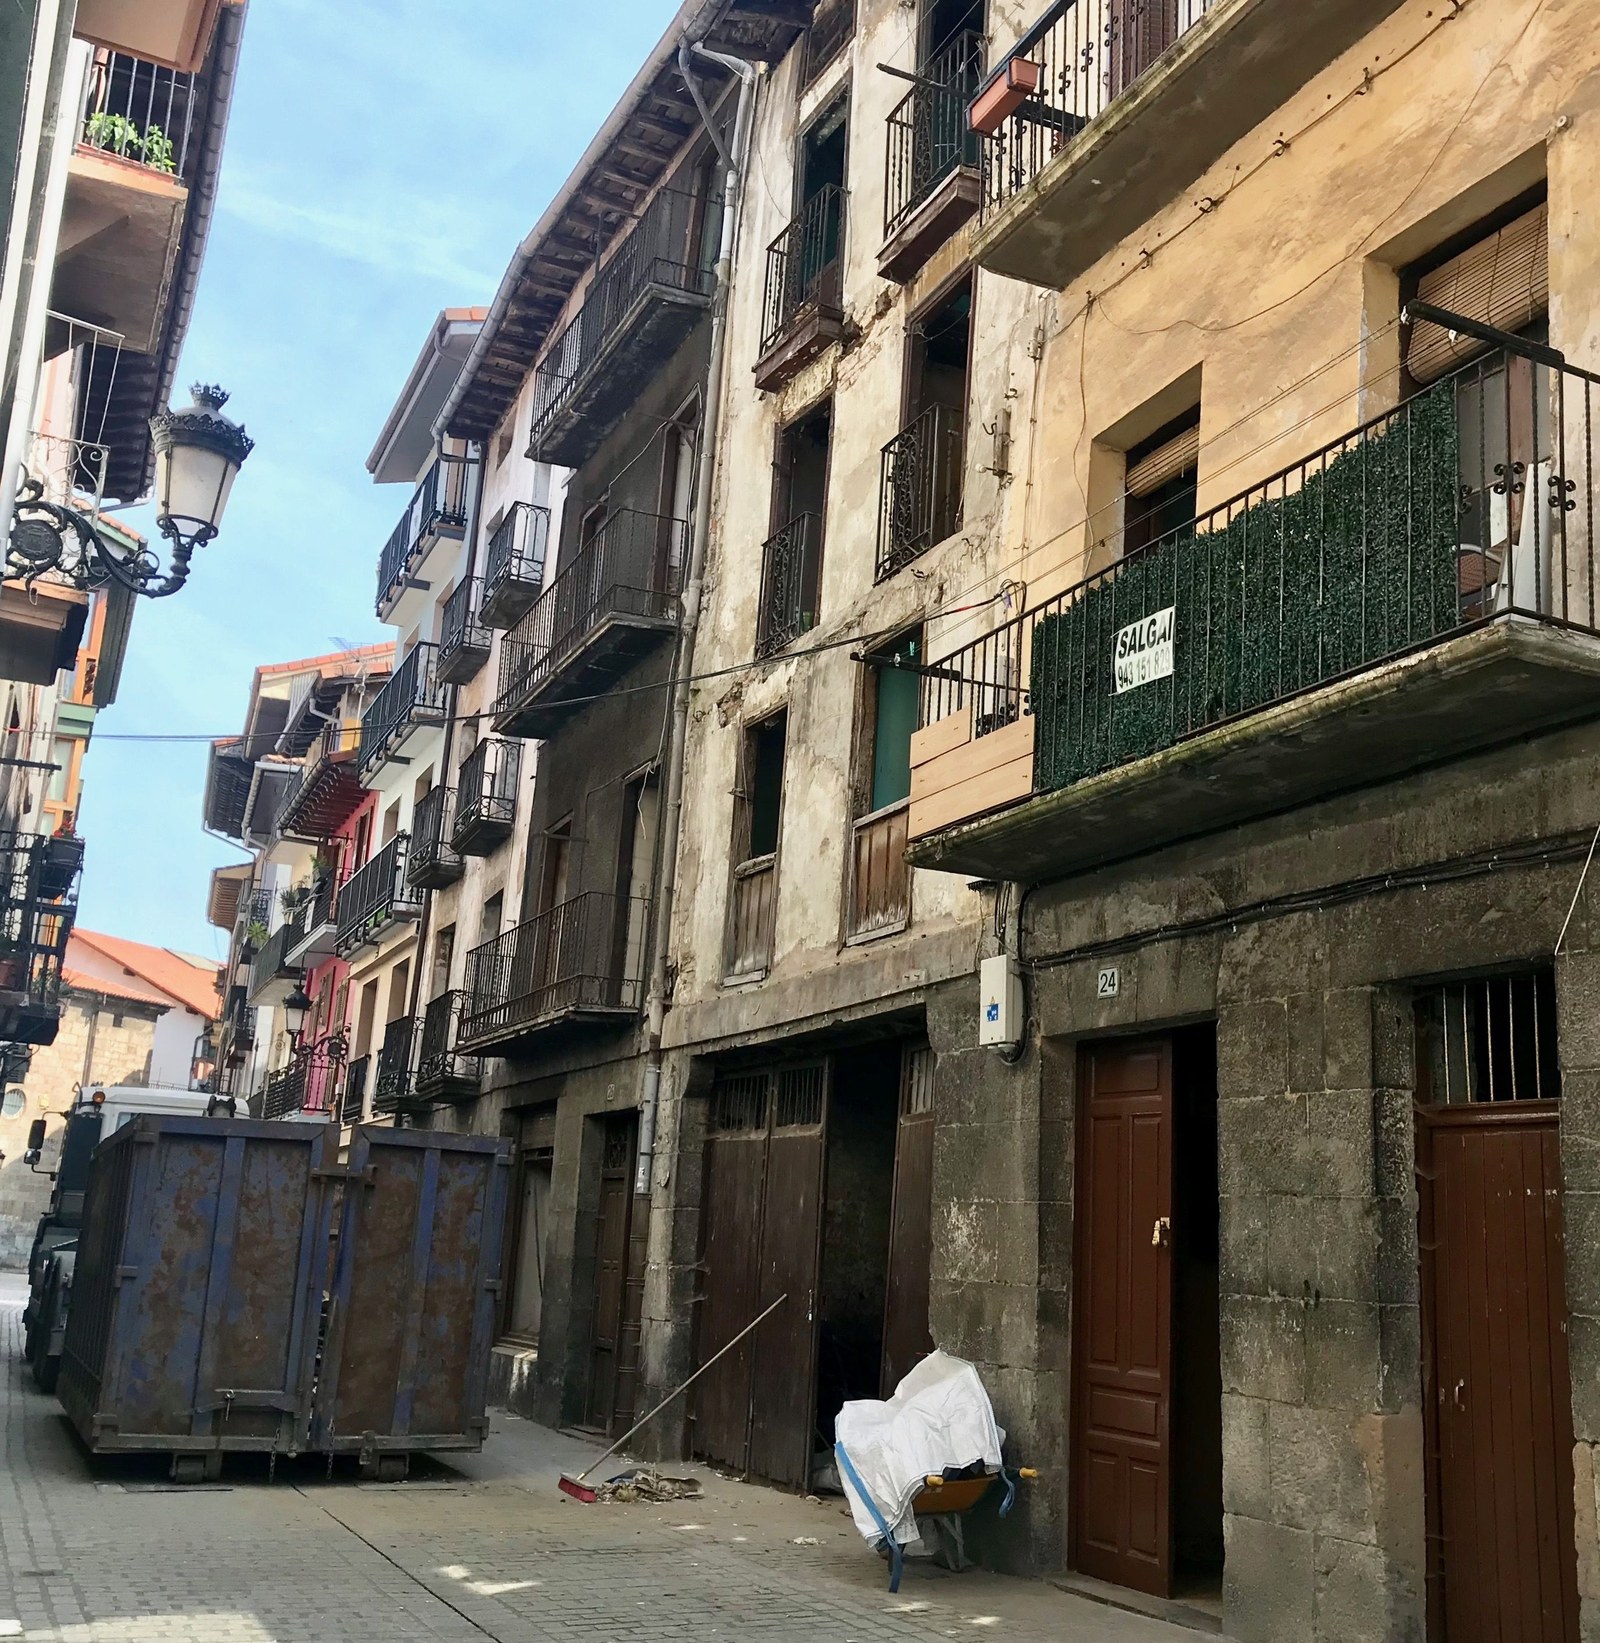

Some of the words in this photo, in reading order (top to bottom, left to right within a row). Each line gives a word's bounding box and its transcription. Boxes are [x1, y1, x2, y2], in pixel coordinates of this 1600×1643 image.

[1118, 611, 1173, 659] SALGAI
[1118, 662, 1134, 689] 943
[1136, 655, 1151, 683] 151
[1154, 646, 1170, 676] 829
[1100, 971, 1116, 993] 24
